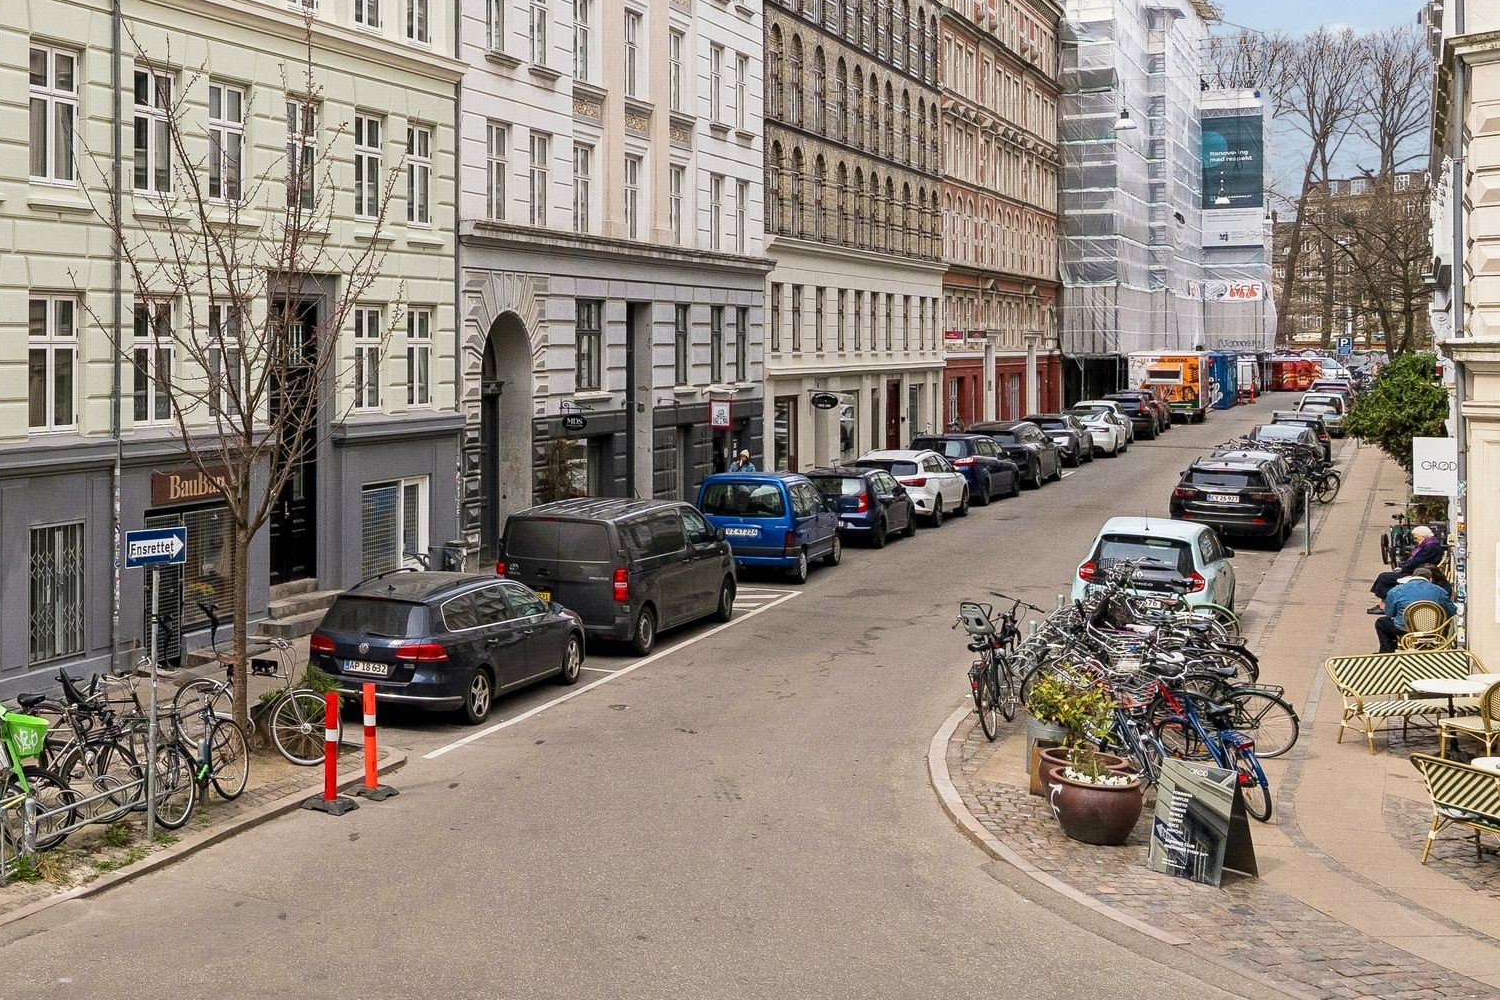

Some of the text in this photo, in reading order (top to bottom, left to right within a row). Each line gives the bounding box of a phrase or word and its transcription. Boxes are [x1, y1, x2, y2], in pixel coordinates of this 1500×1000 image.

[1340, 338, 1349, 347] P
[131, 540, 174, 556] Ensrettet
[350, 662, 386, 673] AP 18 632
